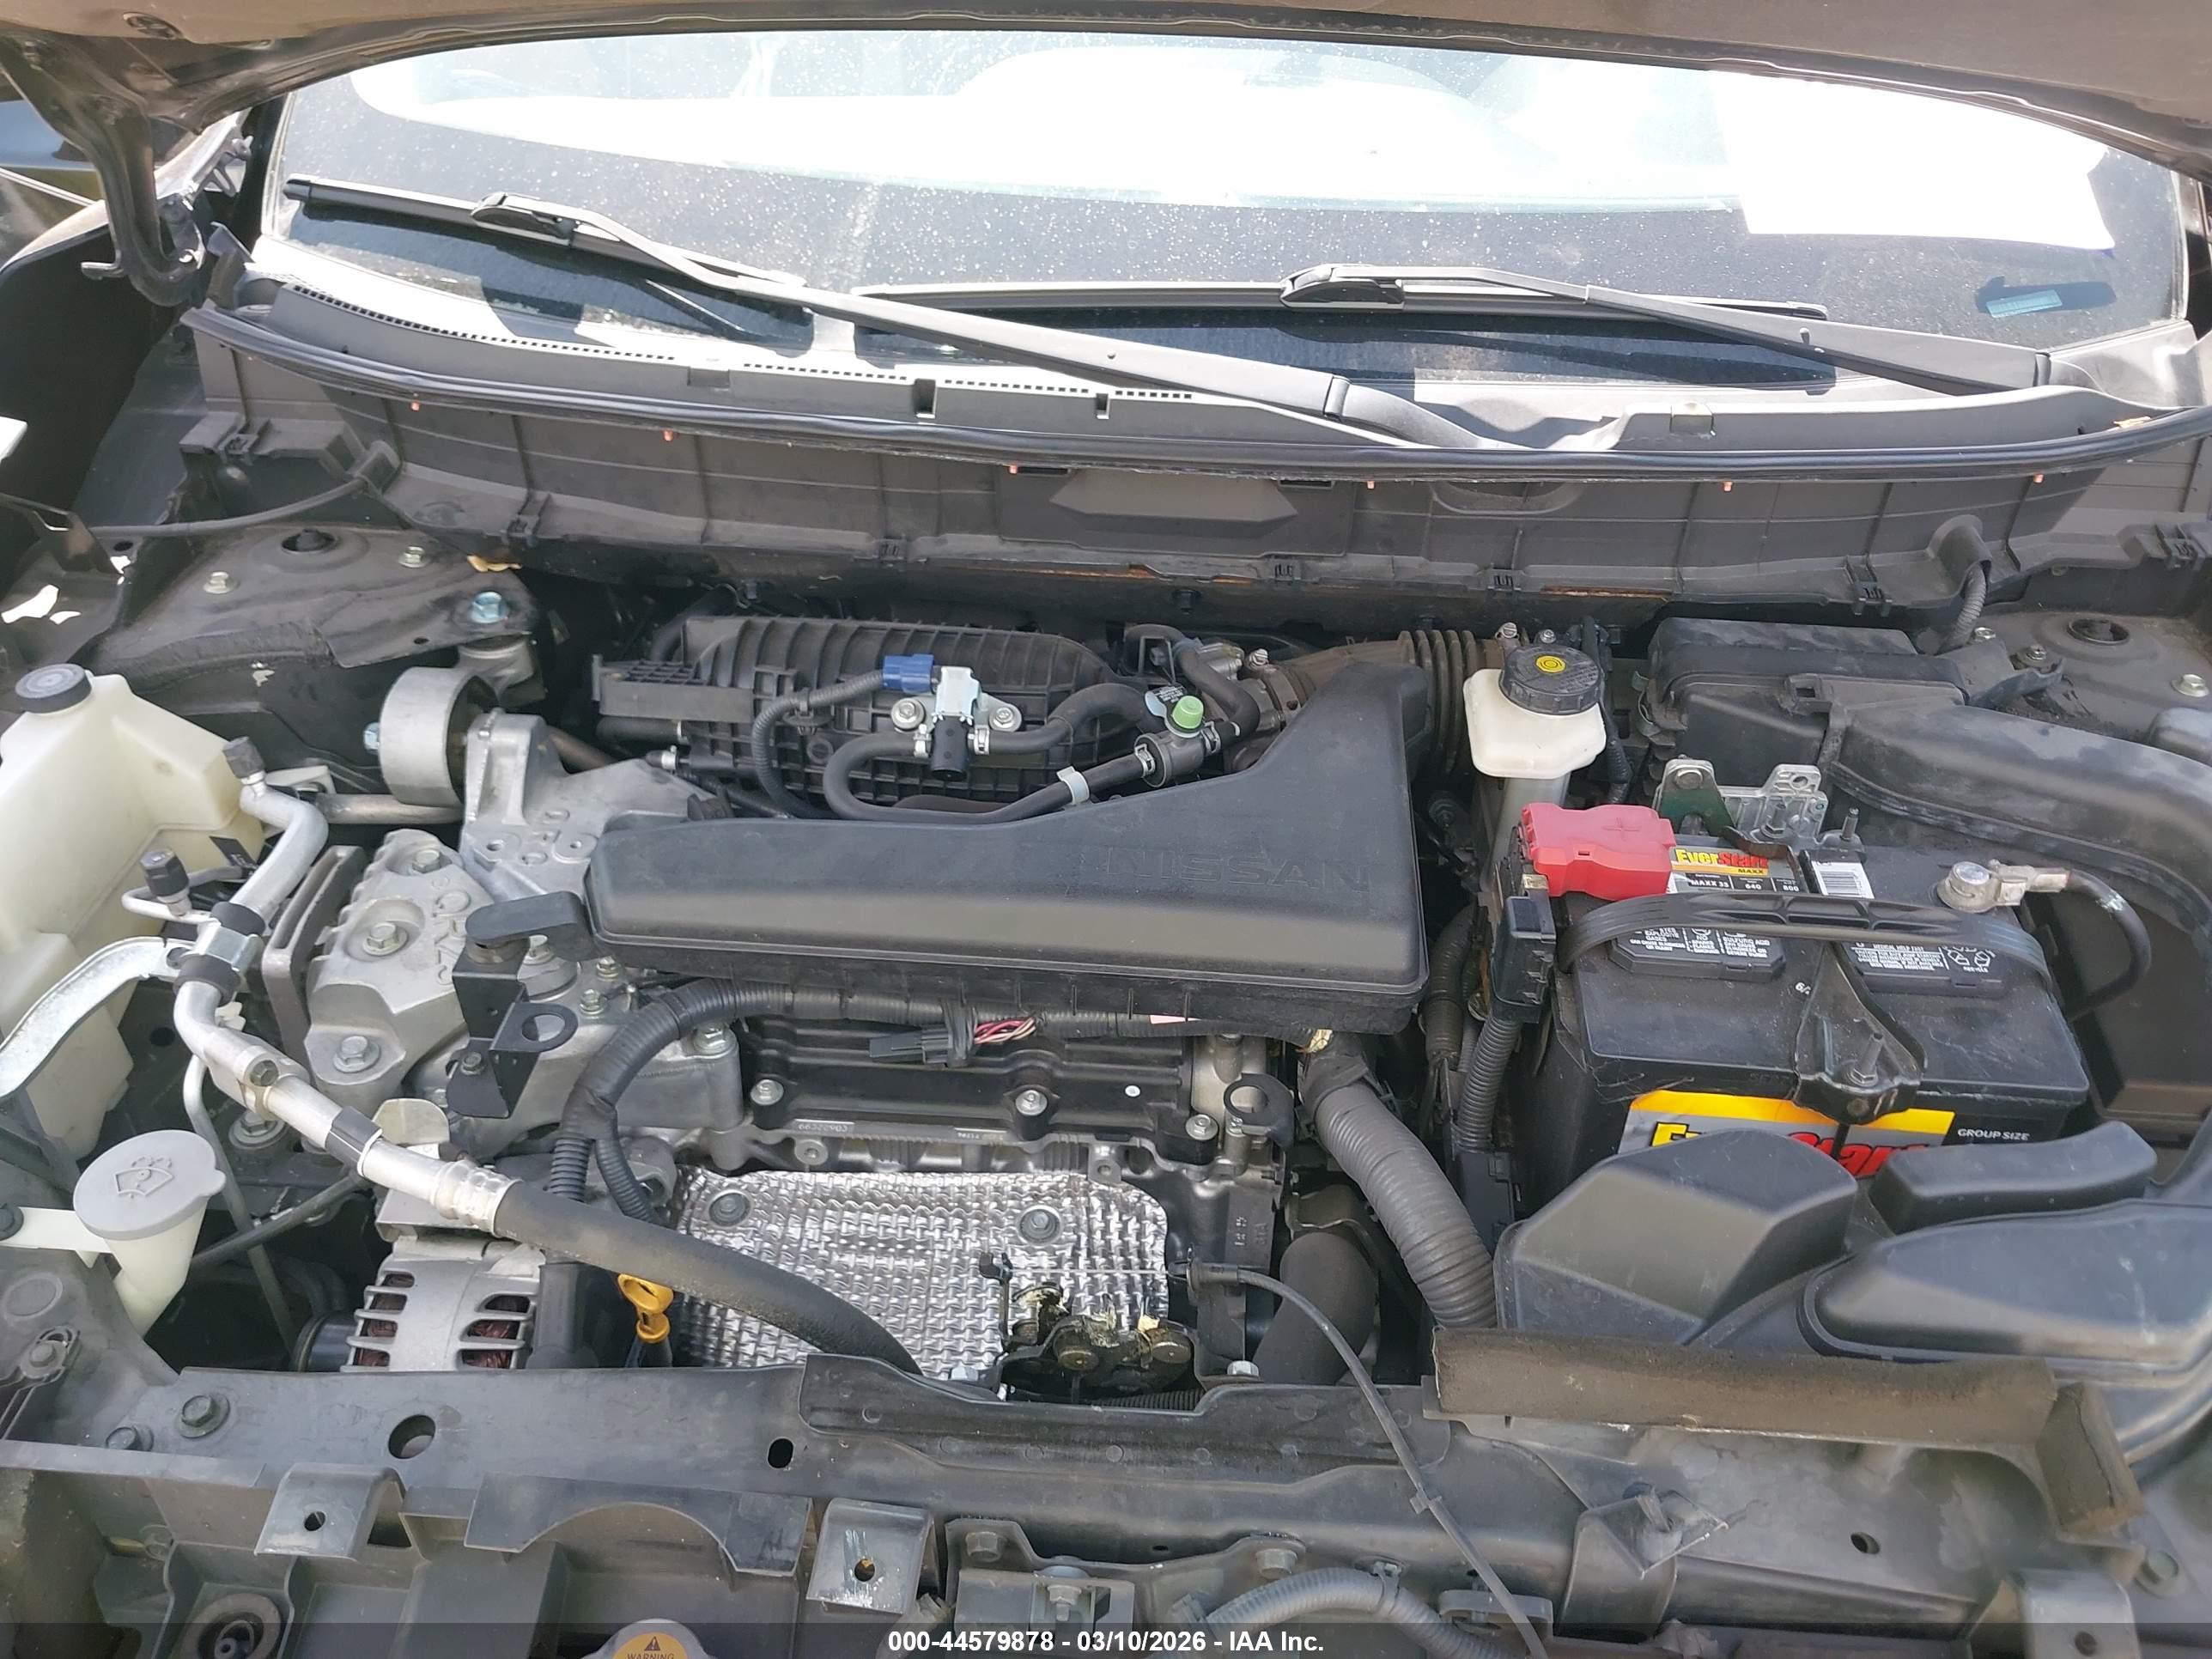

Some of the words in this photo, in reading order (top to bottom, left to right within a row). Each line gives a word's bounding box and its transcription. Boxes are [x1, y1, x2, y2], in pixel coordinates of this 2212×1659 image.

[1675, 848, 1769, 869] EverStart
[1105, 846, 1373, 894] NISSAN
[1957, 1127, 2002, 1139] GROUP
[2002, 1131, 2031, 1141] SIZE
